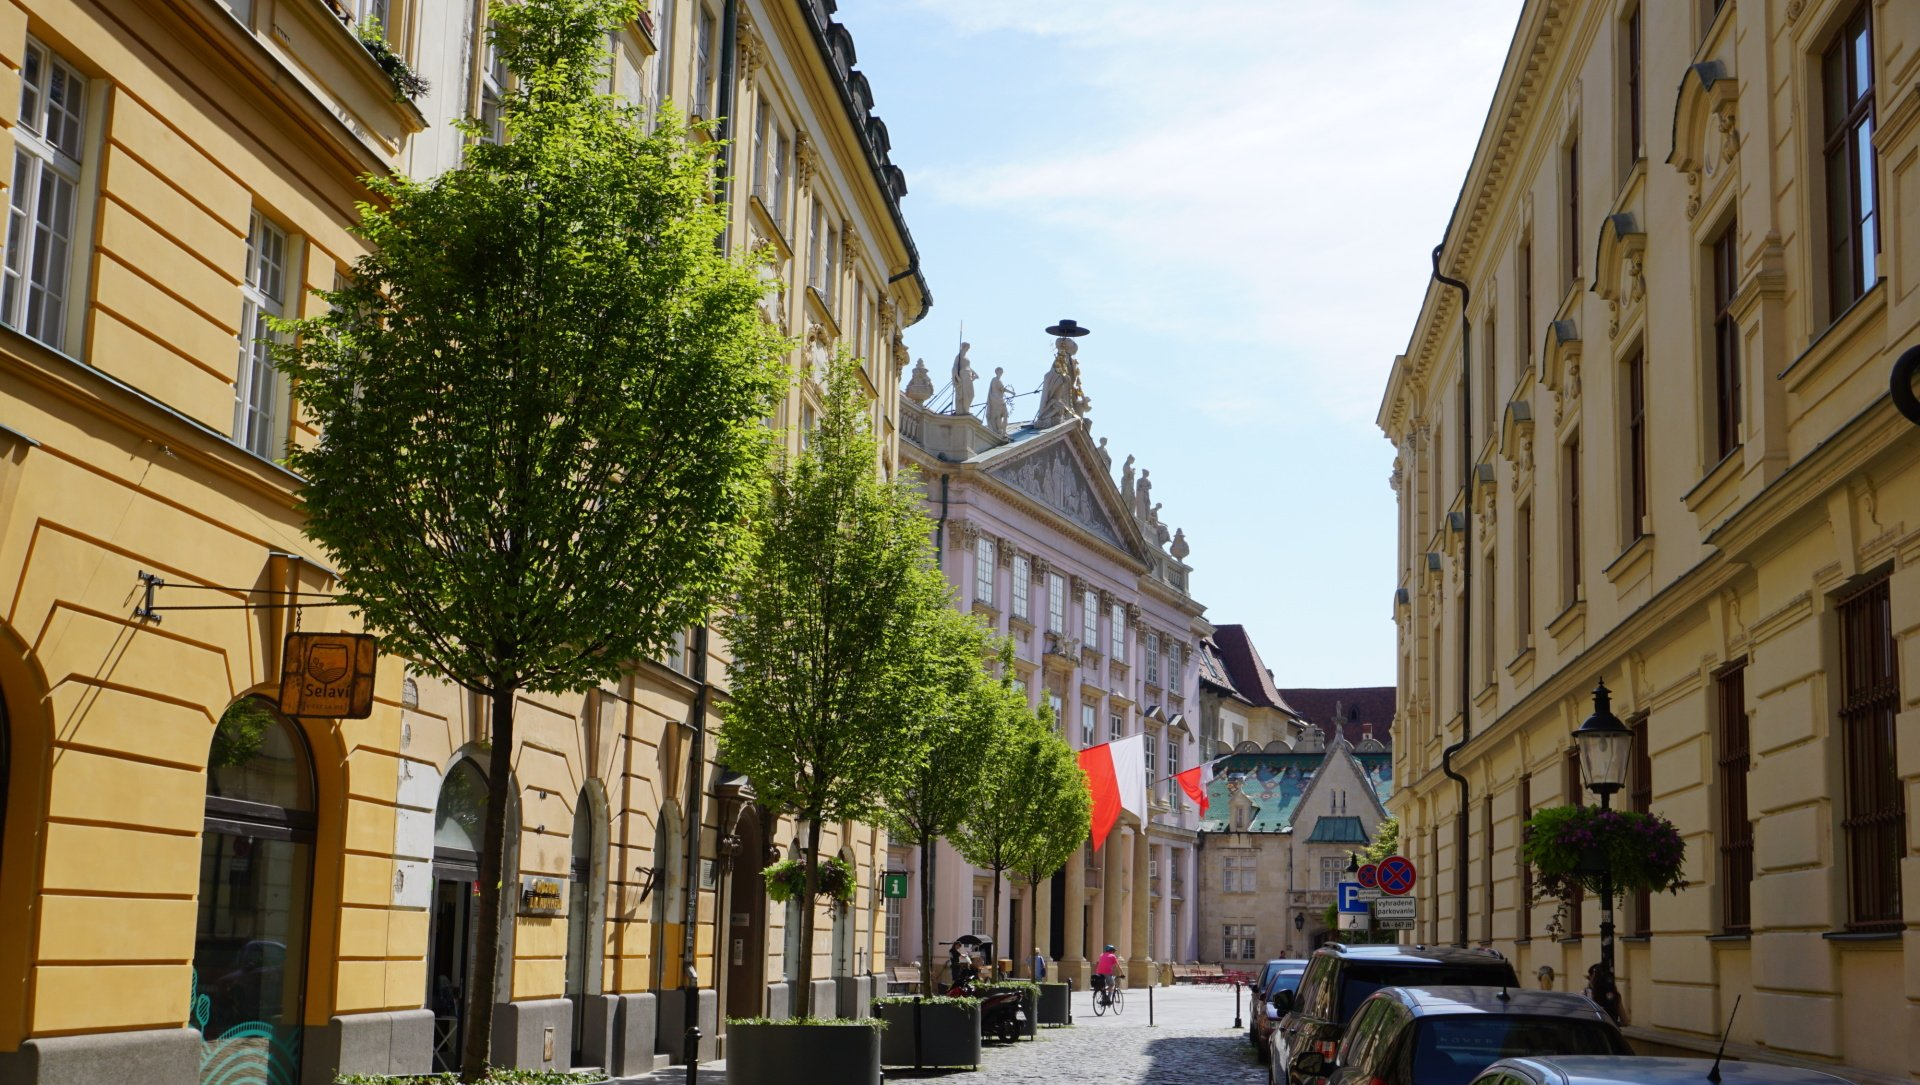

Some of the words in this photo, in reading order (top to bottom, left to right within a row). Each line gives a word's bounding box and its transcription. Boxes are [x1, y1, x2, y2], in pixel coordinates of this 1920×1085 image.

[1345, 886, 1359, 909] P
[1378, 899, 1413, 908] vyhradené
[1377, 907, 1414, 915] parkovanie
